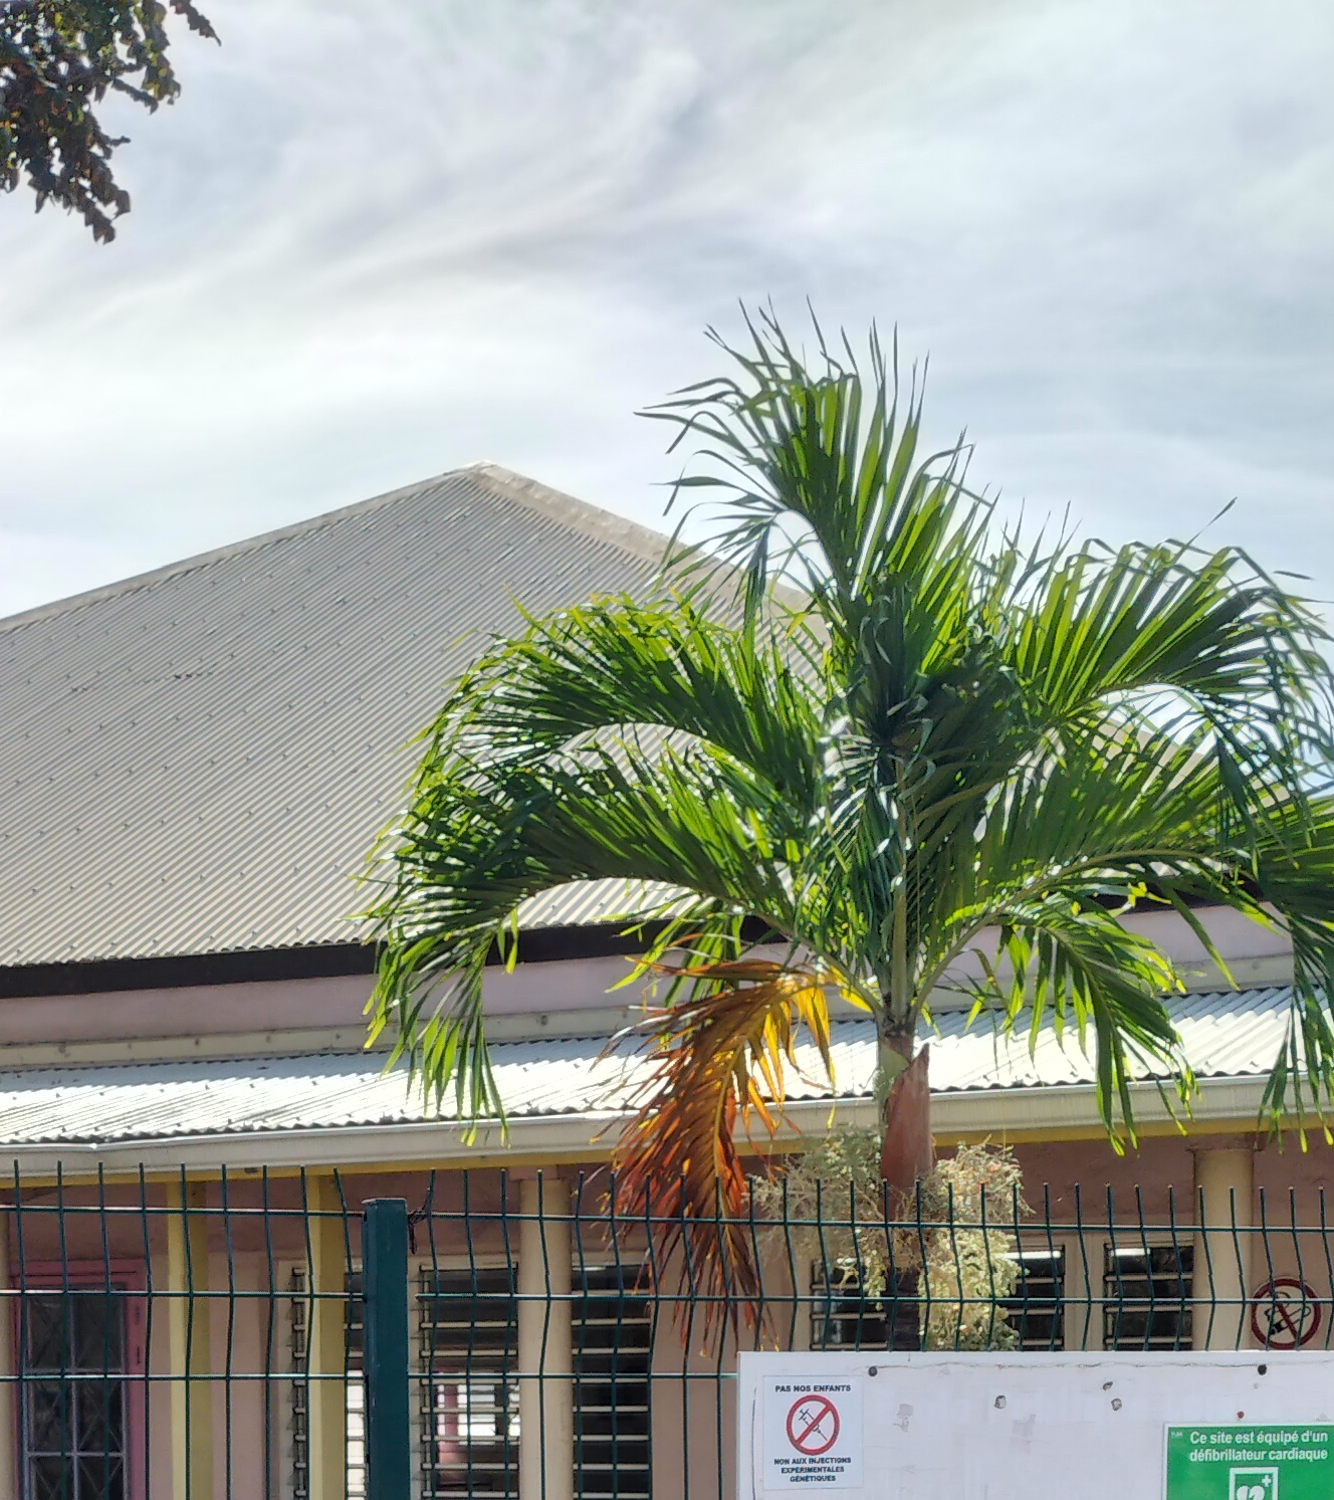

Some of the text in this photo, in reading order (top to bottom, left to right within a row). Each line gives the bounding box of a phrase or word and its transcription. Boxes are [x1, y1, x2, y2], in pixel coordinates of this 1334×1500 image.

[1190, 1431, 1207, 1444] Ce
[1210, 1431, 1232, 1443] site
[1235, 1431, 1255, 1443] est
[1256, 1430, 1299, 1446] équipé
[1301, 1430, 1328, 1443] d'un
[1189, 1447, 1327, 1462] défibrillateur cardiaque
